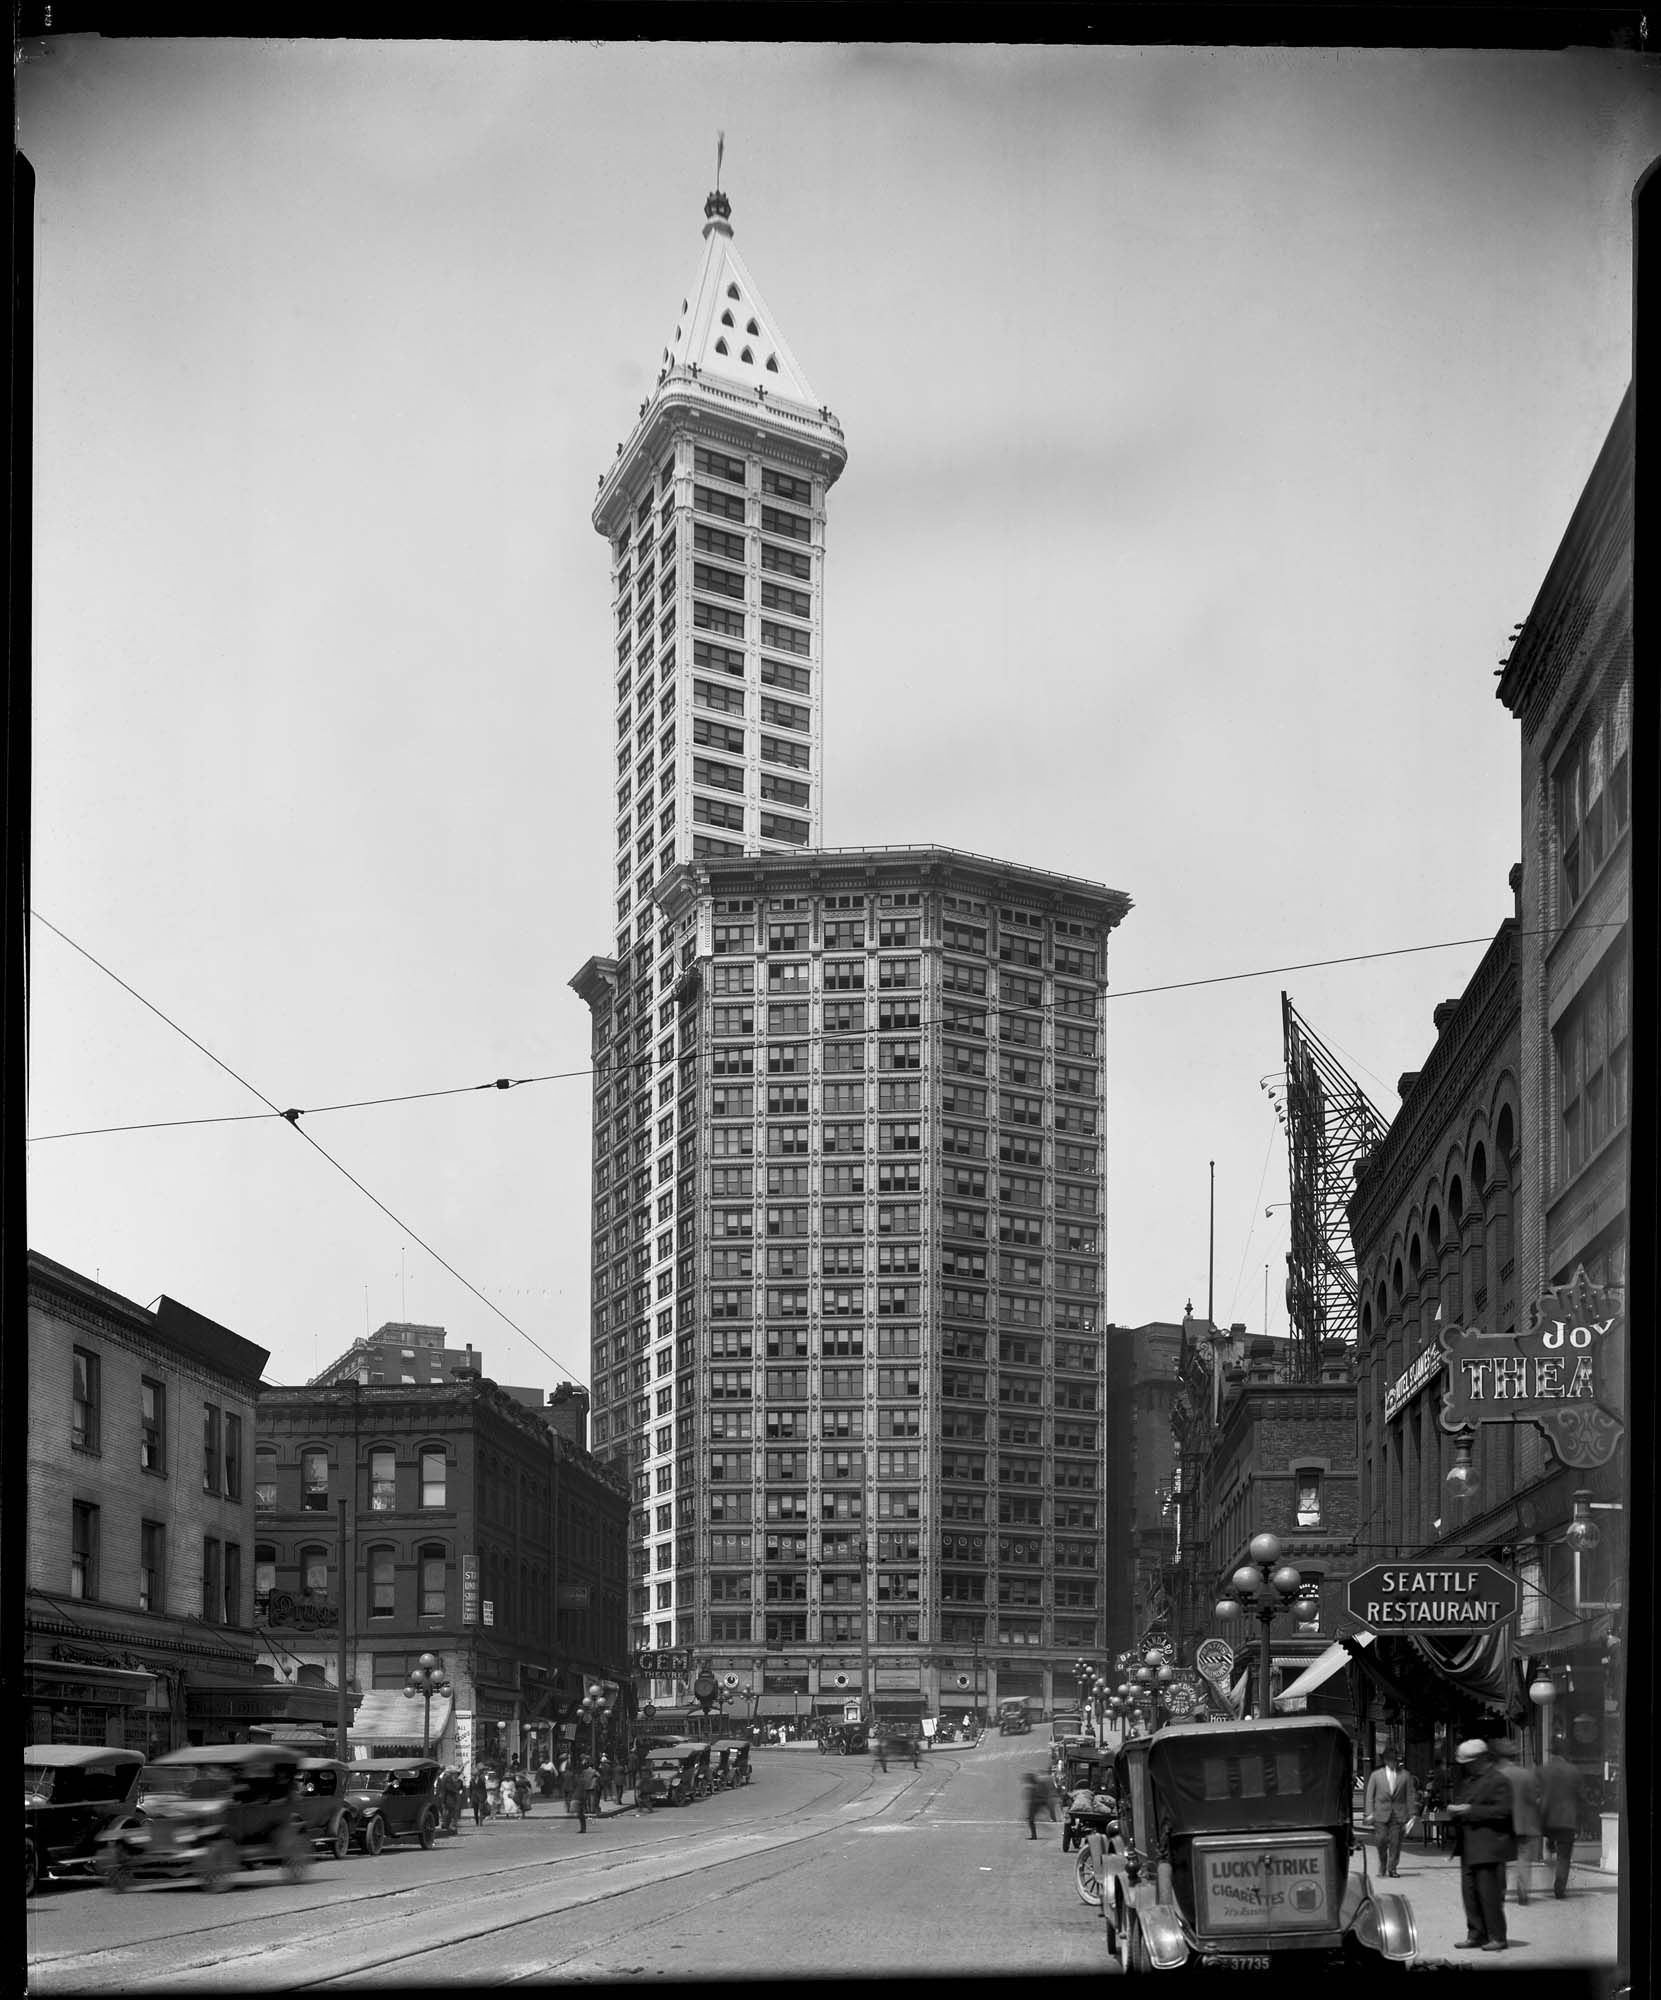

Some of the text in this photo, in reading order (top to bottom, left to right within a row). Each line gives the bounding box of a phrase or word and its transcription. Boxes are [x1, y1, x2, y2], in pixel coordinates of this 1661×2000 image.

[1367, 1601, 1499, 1622] RESTAURANT
[1142, 1636, 1173, 1655] STANDARD
[1202, 1642, 1228, 1655] BATHS
[639, 1653, 688, 1669] GEM
[644, 1671, 683, 1679] THEATRE
[1170, 1704, 1190, 1714] SHOP
[1212, 1858, 1320, 1879] LUCKY STRIKE
[1212, 1884, 1285, 1905] CIGARETTES
[1231, 1958, 1269, 1970] 37735
